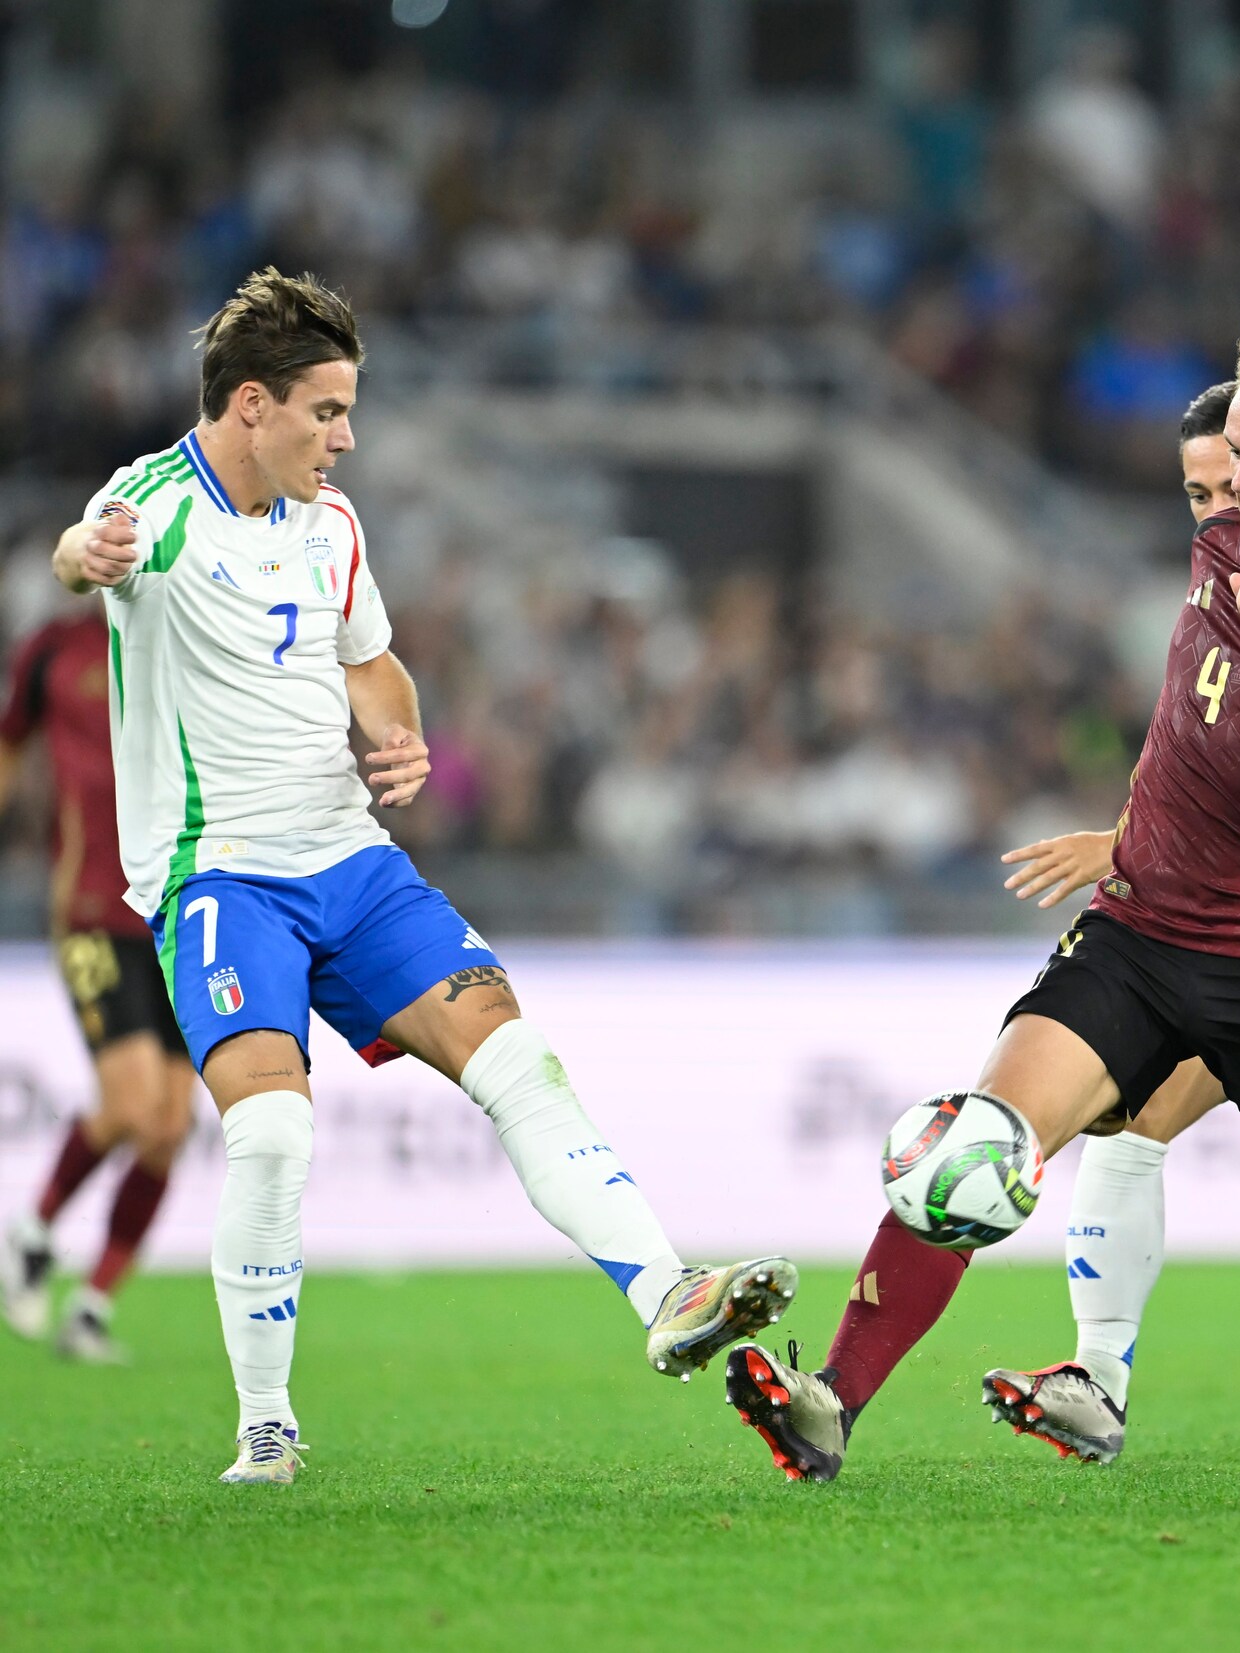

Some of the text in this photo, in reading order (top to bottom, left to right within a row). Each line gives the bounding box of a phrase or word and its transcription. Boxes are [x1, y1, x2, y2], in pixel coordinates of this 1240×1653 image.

[266, 602, 299, 666] 7
[1196, 646, 1232, 724] 4
[184, 895, 219, 968] 7
[210, 975, 236, 993] ITALIA
[567, 1144, 616, 1160] ITA
[242, 1259, 303, 1277] ITALIA
